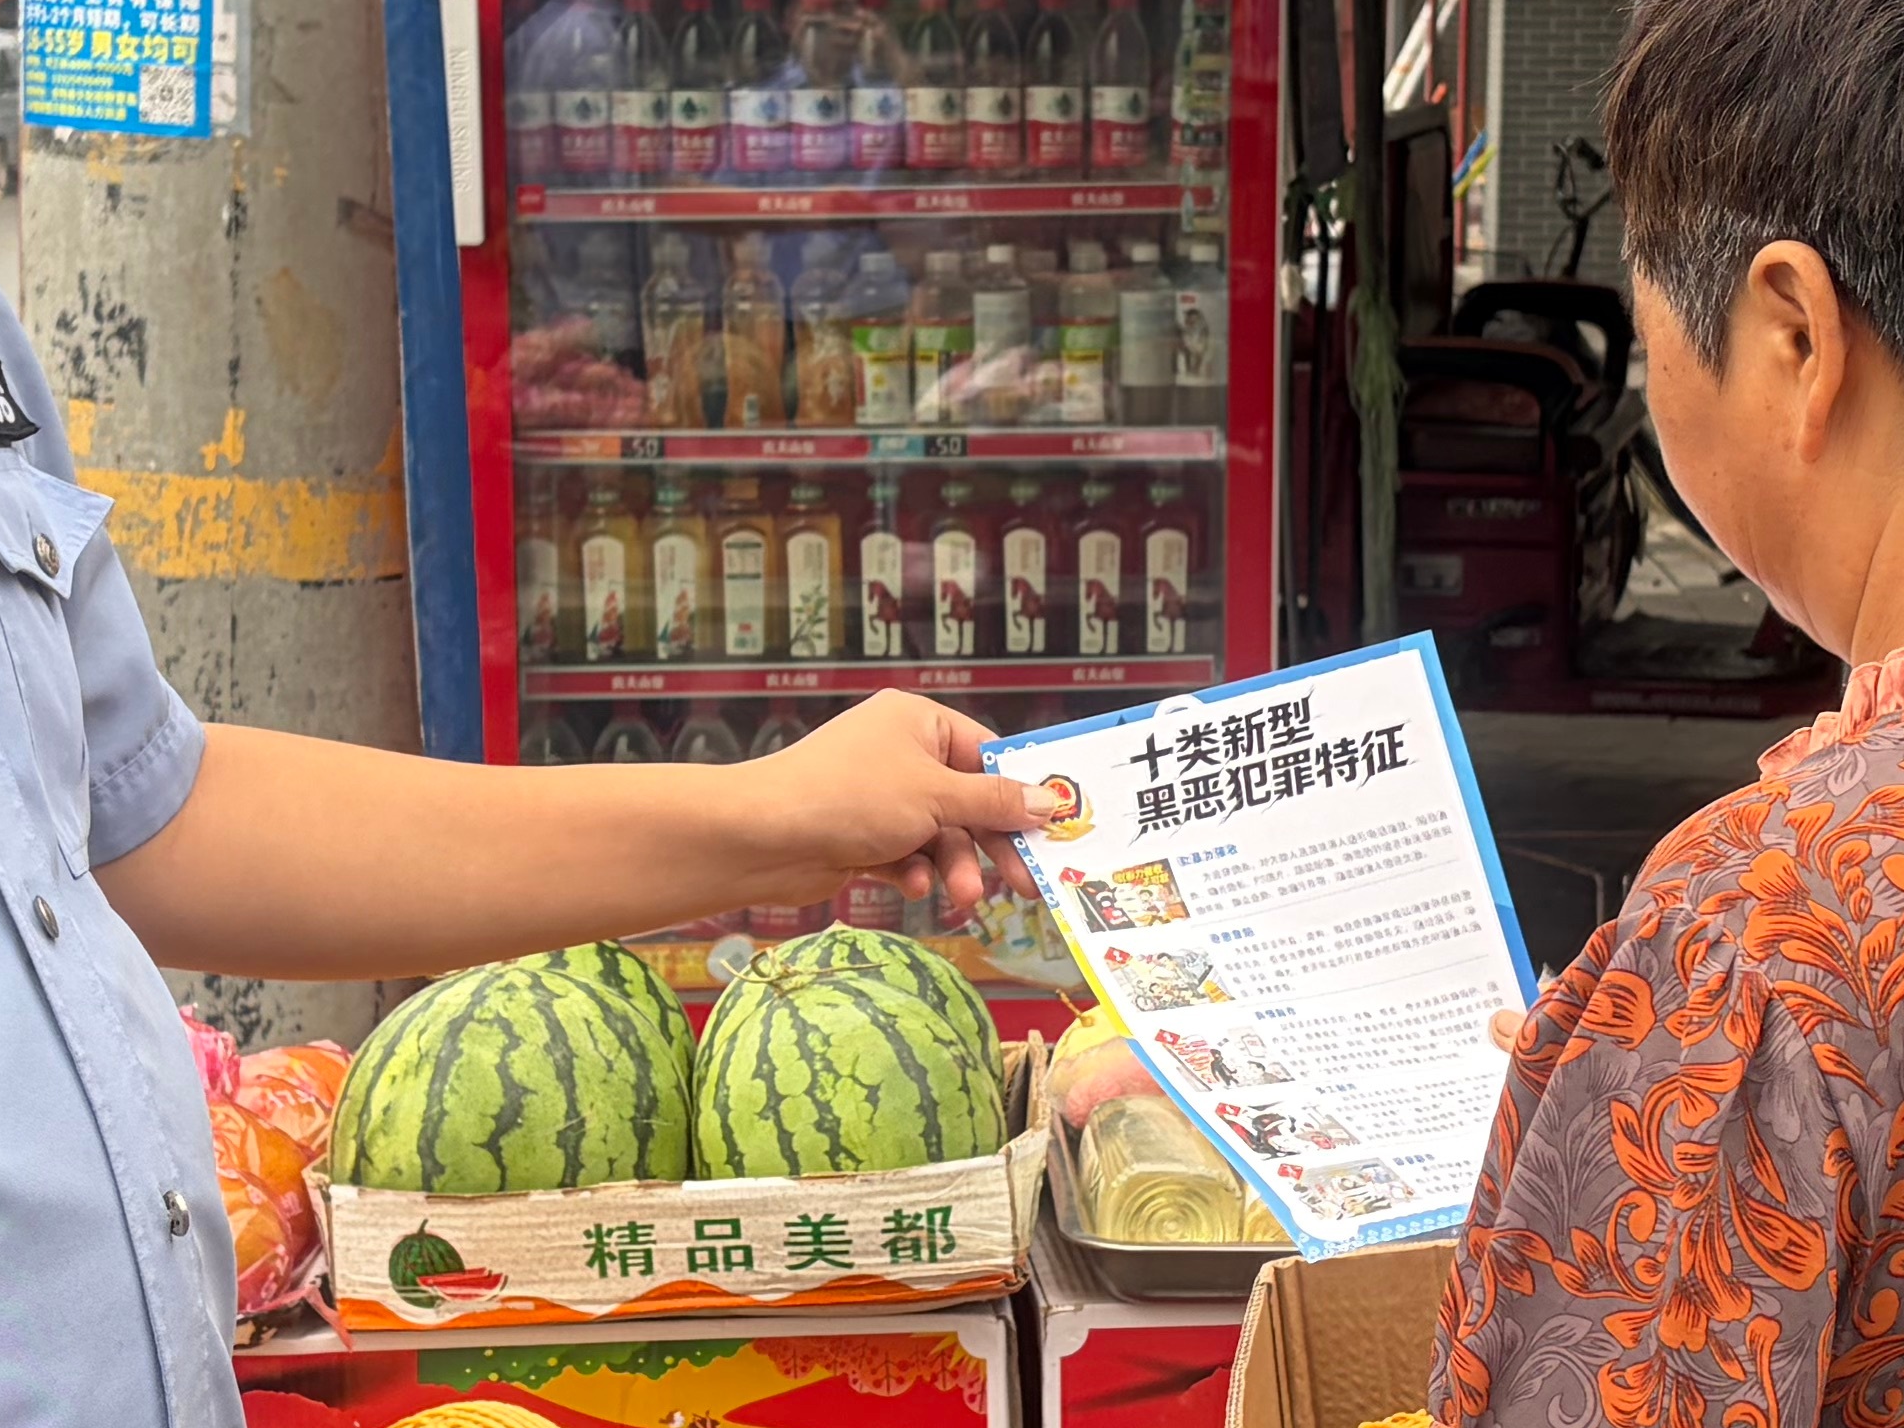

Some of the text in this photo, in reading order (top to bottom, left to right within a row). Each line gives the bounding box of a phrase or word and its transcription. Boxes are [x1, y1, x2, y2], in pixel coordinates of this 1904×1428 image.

[1129, 694, 1316, 782] 十类新型
[1134, 721, 1410, 836] 黑恶犯罪特征
[583, 1206, 957, 1280] 精品美都
